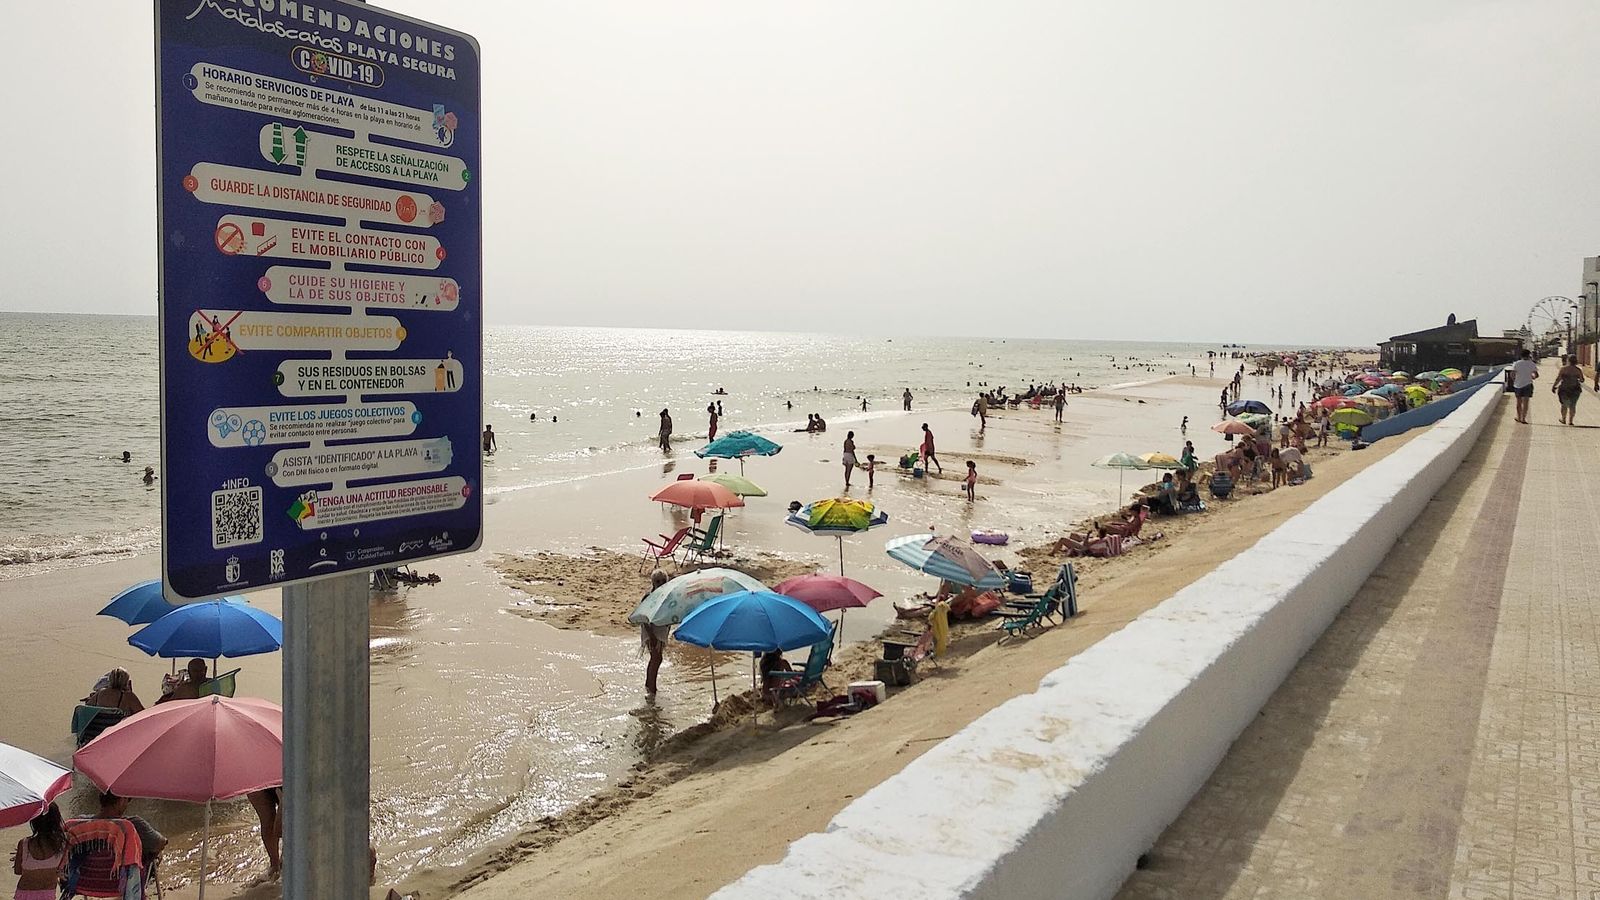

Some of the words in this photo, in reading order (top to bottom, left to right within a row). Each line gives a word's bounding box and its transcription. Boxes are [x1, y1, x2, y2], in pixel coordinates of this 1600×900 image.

[348, 41, 399, 66] PLAYA
[402, 56, 456, 81] SEGURA
[203, 67, 253, 87] HORARIO
[255, 79, 309, 98] SERVICIOS
[310, 90, 323, 102] DE
[325, 93, 355, 108] PLAYA
[360, 103, 367, 111] de
[368, 104, 377, 113] las
[377, 106, 384, 114] 11
[389, 108, 398, 117] las
[398, 110, 405, 118] 21
[406, 111, 421, 121] horas
[205, 81, 214, 91] Se
[216, 85, 255, 99] recomienda
[268, 95, 304, 109] permanecer
[306, 100, 320, 111] más
[321, 103, 330, 112] de
[331, 106, 335, 114] 4
[337, 106, 353, 117] horas
[363, 112, 369, 120] la
[370, 114, 385, 125] playa
[386, 118, 393, 126] en
[395, 118, 413, 130] horario
[415, 123, 422, 131] de
[205, 92, 233, 104] mañana
[240, 99, 257, 109] tarde
[259, 102, 273, 112] para
[274, 104, 291, 115] evitar
[293, 109, 341, 125] aglomeraciones.
[336, 145, 375, 160] RESPETE
[377, 151, 388, 162] LA
[390, 153, 449, 173] SEÑALIZACIÓN
[336, 157, 348, 168] DE
[350, 159, 391, 175] ACCESOS
[392, 166, 399, 176] A
[400, 168, 411, 178] LA
[413, 170, 439, 182] PLAYA
[210, 178, 255, 196] GUARDE
[257, 183, 271, 197] LA
[273, 186, 325, 204] DISTANCIA
[327, 193, 339, 206] DE
[341, 194, 392, 213] SEGURIDAD
[292, 228, 324, 241] EVITE
[328, 231, 341, 243] EL
[345, 233, 401, 248] CONTACTO
[405, 238, 425, 251] CON
[292, 242, 305, 254] EL
[309, 244, 376, 260] MOBILIARIO
[380, 249, 424, 264] PÚBLICO
[289, 274, 325, 287] CUIDE
[330, 277, 345, 288] SU
[350, 279, 395, 292] HIGIENE
[399, 281, 405, 292] Y
[289, 288, 304, 299] LA
[309, 288, 324, 299] DE
[328, 290, 352, 301] SUS
[356, 291, 405, 303] OBJETOS
[240, 324, 273, 337] EVITE
[277, 325, 342, 338] COMPARTIR
[345, 326, 392, 339] OBJETOS
[298, 366, 319, 377] SUS
[323, 366, 372, 377] RESIDUOS
[375, 366, 387, 376] EN
[390, 365, 425, 376] BOLSAS
[298, 380, 305, 391] Y
[308, 380, 321, 391] EN
[325, 379, 337, 390] EL
[340, 378, 404, 390] CONTENEDOR
[270, 411, 296, 422] EVITE
[298, 410, 315, 421] LOS
[318, 409, 353, 420] JUEGOS
[355, 406, 405, 419] COLECTIVOS
[270, 423, 278, 431] Se
[279, 421, 314, 430] recomienda
[326, 419, 346, 428] realizar
[394, 417, 406, 425] para
[270, 430, 288, 439] evitar
[289, 429, 314, 438] contacto
[315, 428, 330, 436] entre
[282, 456, 312, 468] ASISTA
[315, 450, 376, 466] "IDENTIFICADO"
[378, 450, 383, 459] A
[384, 450, 394, 459] LA
[396, 447, 418, 458] PLAYA
[282, 469, 294, 477] Con
[296, 468, 307, 476] DNI
[338, 464, 360, 473] formato
[221, 477, 250, 490] +INFO
[318, 494, 345, 507] TENGA
[346, 492, 364, 504] UNA
[364, 488, 396, 501] ACTITUD
[398, 483, 448, 497] RESPONSABLE
